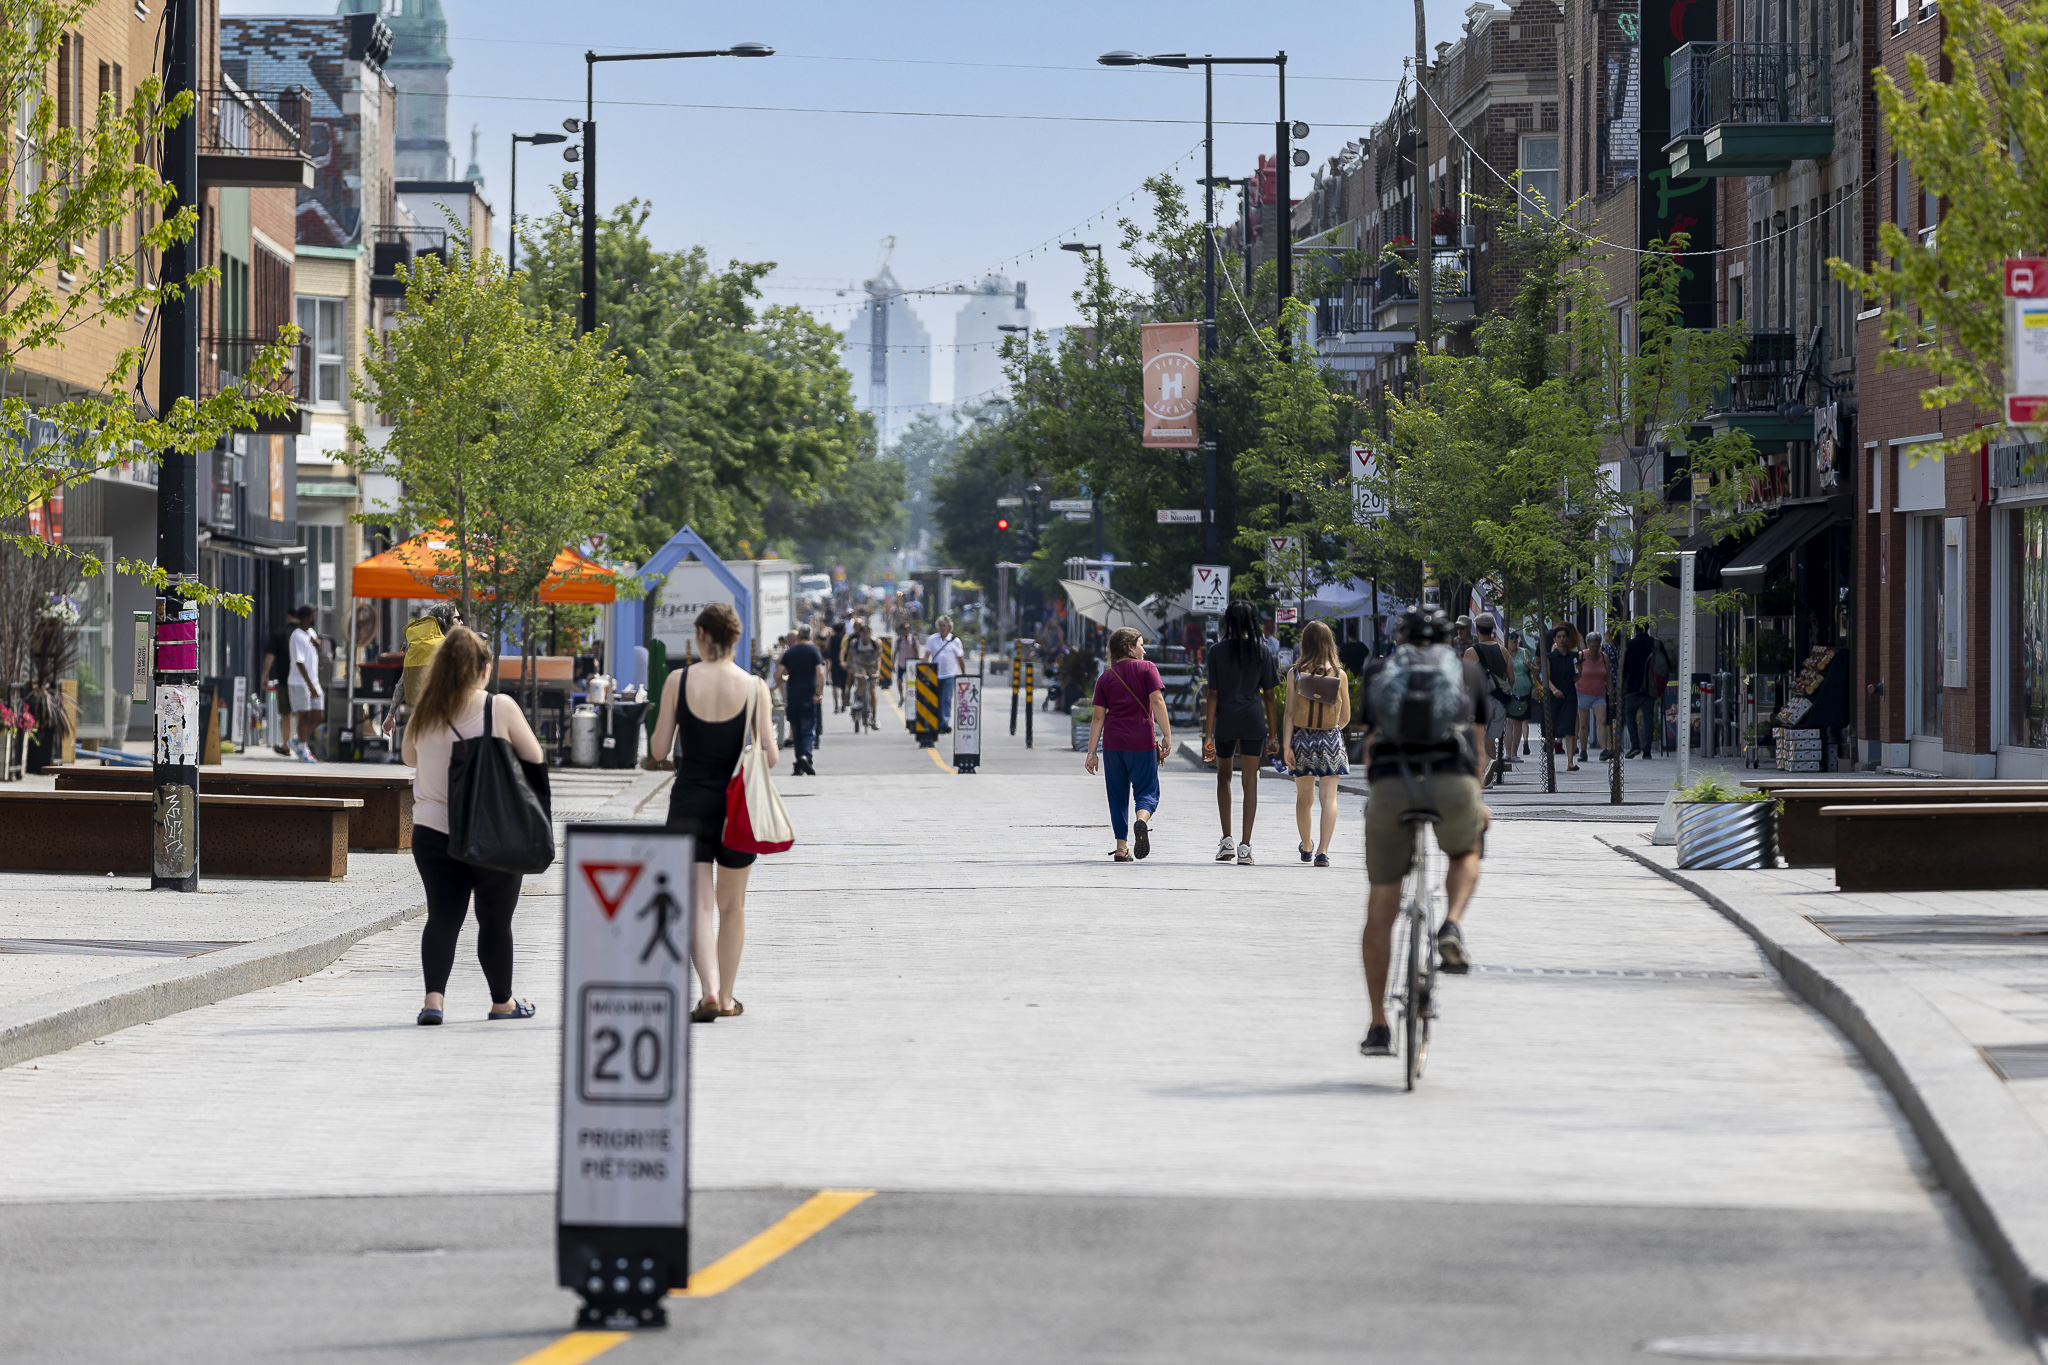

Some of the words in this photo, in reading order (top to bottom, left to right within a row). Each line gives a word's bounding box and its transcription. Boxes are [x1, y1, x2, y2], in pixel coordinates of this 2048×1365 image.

[1154, 357, 1189, 371] VIVEZ
[1161, 372, 1183, 401] H
[1361, 493, 1380, 508] 20
[1170, 514, 1197, 522] Nicolet
[959, 714, 975, 727] 20
[593, 1026, 662, 1084] 20
